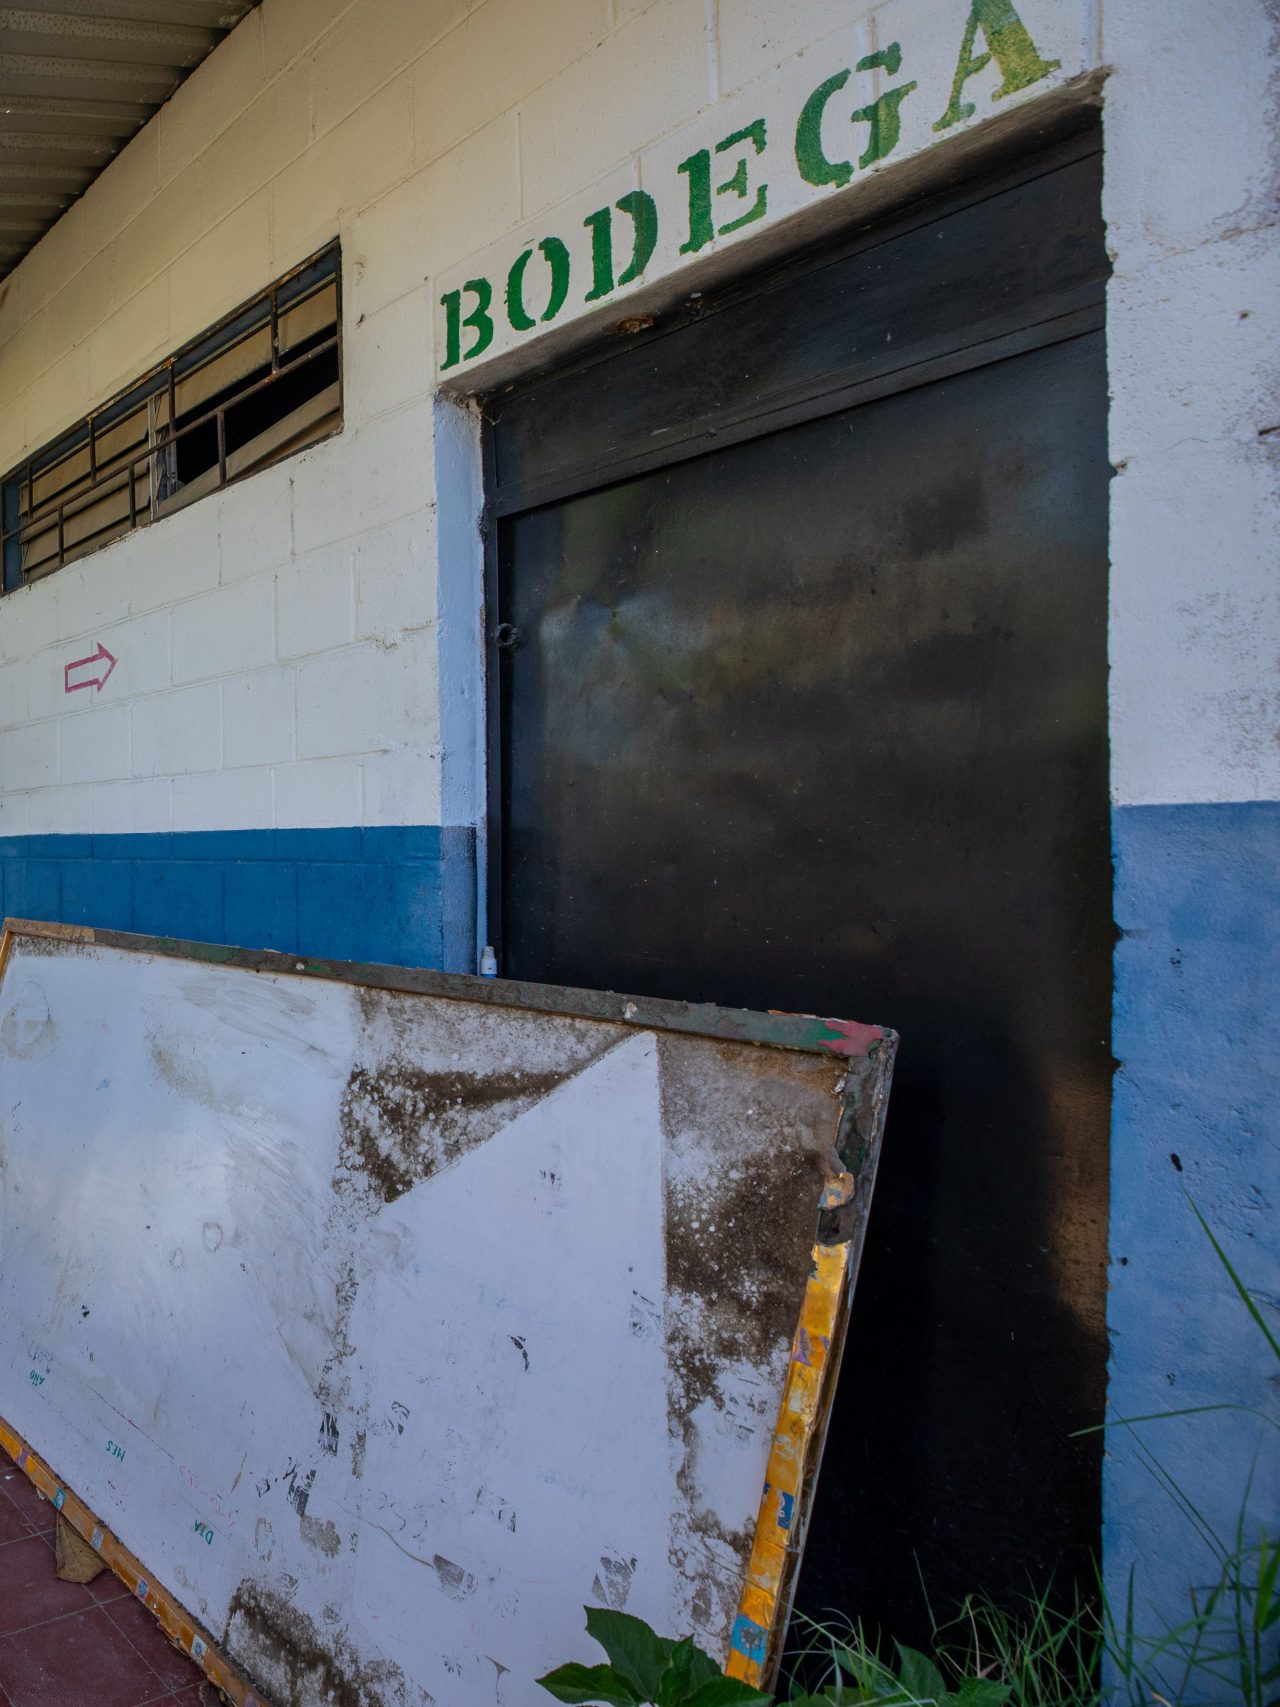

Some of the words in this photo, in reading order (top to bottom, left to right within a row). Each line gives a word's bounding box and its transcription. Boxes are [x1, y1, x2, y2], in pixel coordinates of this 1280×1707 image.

[439, 0, 1062, 370] BODEGA
[105, 1440, 126, 1461] MES
[194, 1519, 214, 1545] DIA
